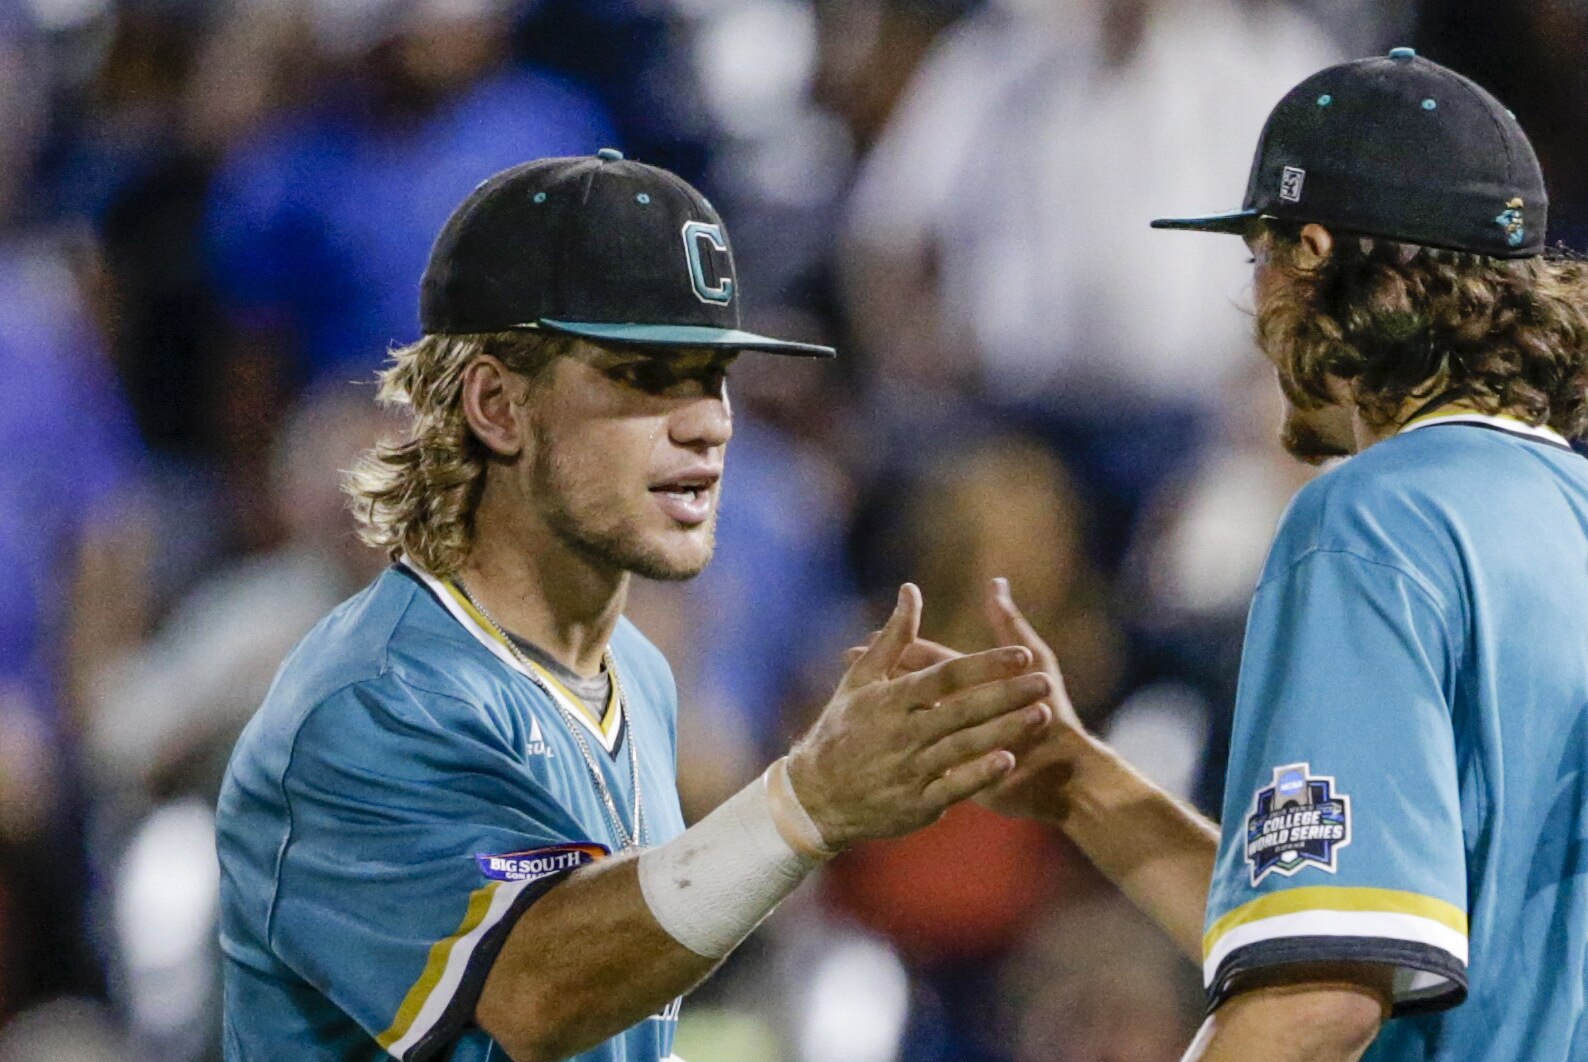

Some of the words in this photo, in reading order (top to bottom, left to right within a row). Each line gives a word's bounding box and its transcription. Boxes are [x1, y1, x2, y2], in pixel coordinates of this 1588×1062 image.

[682, 220, 733, 306] C
[1263, 811, 1322, 834] COLLEGE
[1248, 832, 1289, 856] WORLD
[1290, 825, 1344, 841] SERIES
[489, 857, 518, 871] BIG
[518, 851, 581, 873] SOUTH
